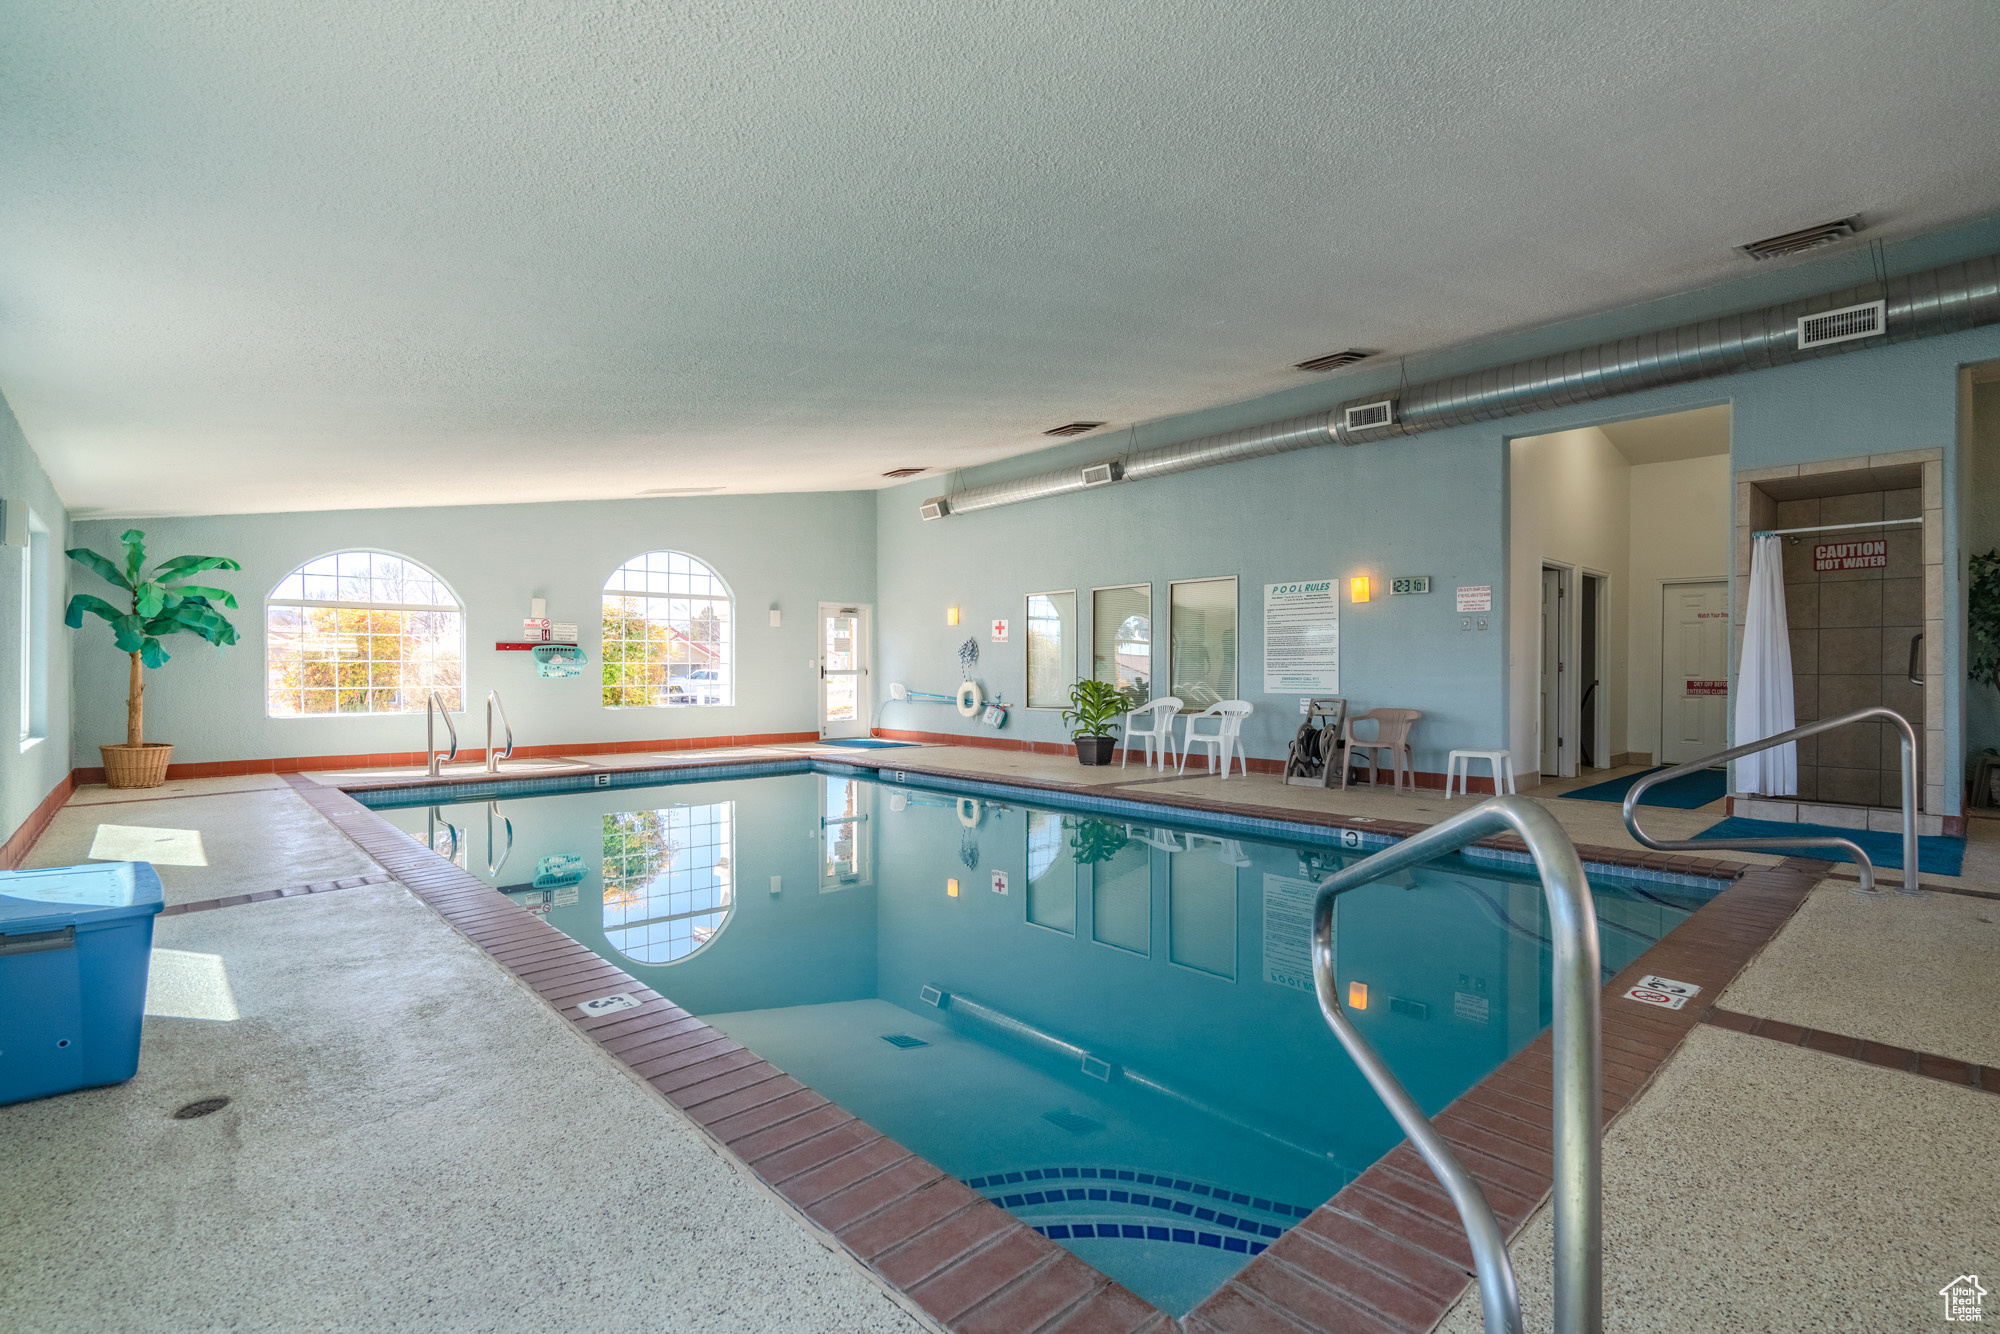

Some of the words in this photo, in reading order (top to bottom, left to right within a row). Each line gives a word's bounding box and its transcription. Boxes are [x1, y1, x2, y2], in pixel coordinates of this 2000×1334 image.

[1815, 541, 1885, 559] CAUTION
[1816, 559, 1840, 571] HOT
[1842, 555, 1886, 569] WATER
[1272, 584, 1303, 594] POOL
[1304, 582, 1331, 592] RULES
[542, 630, 550, 640] 14
